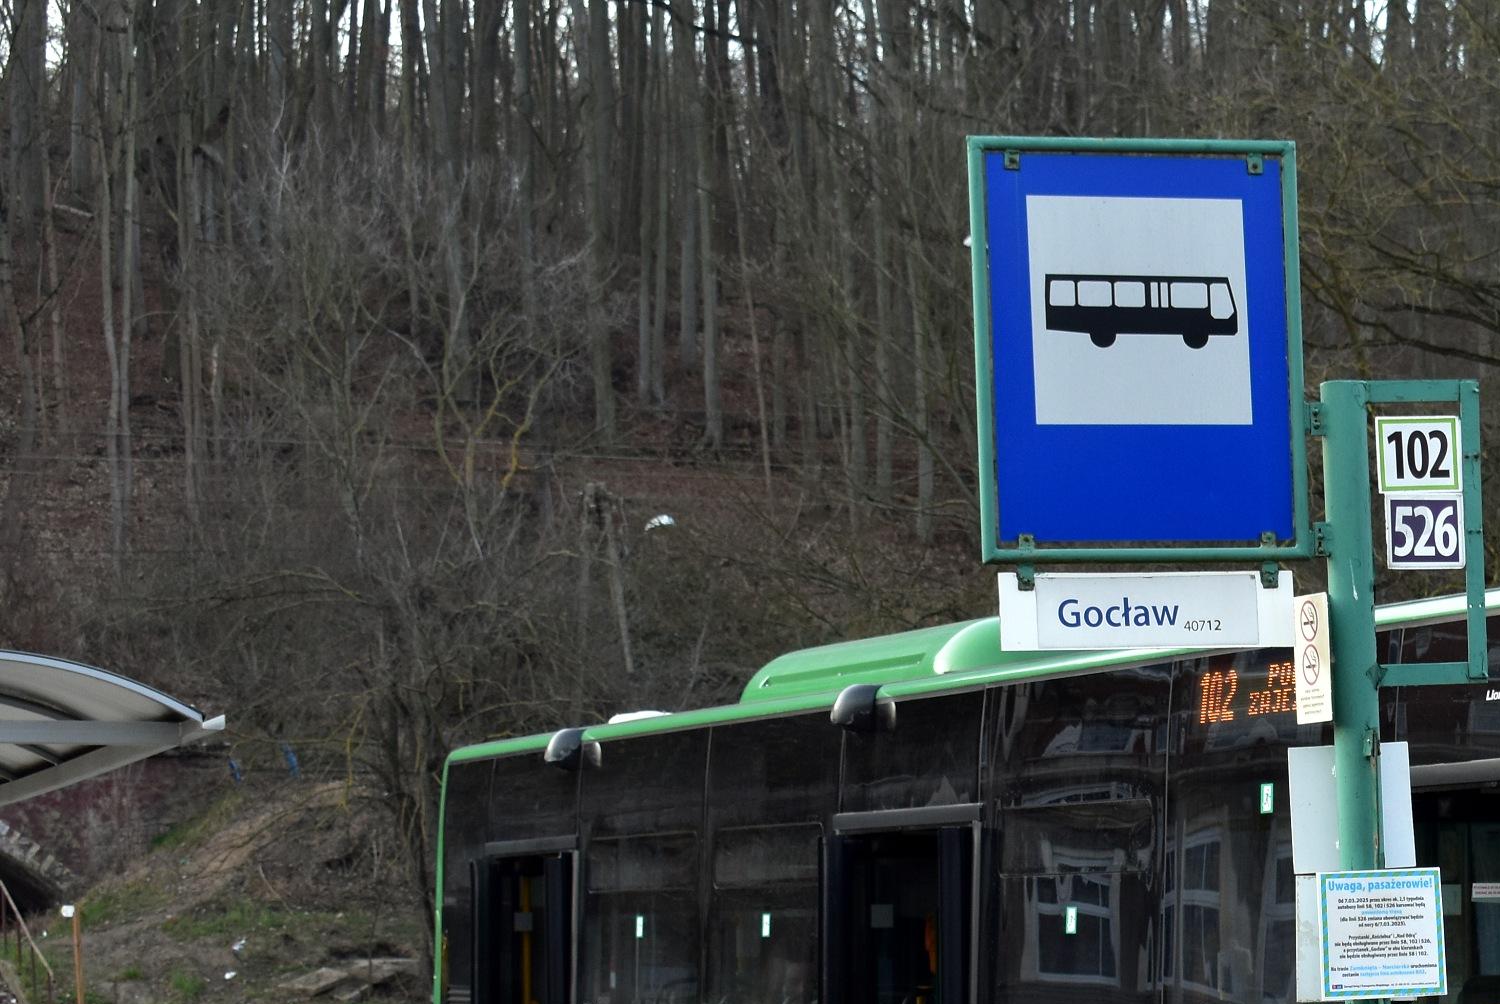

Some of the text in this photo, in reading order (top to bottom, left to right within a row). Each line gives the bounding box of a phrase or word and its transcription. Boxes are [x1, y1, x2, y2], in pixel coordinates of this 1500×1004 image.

[1387, 430, 1450, 479] 102
[1394, 506, 1458, 557] 526
[1058, 597, 1222, 632] Gocław 40712
[1200, 669, 1238, 724] 102
[1328, 878, 1432, 892] Uwaga, pasażerowie!
